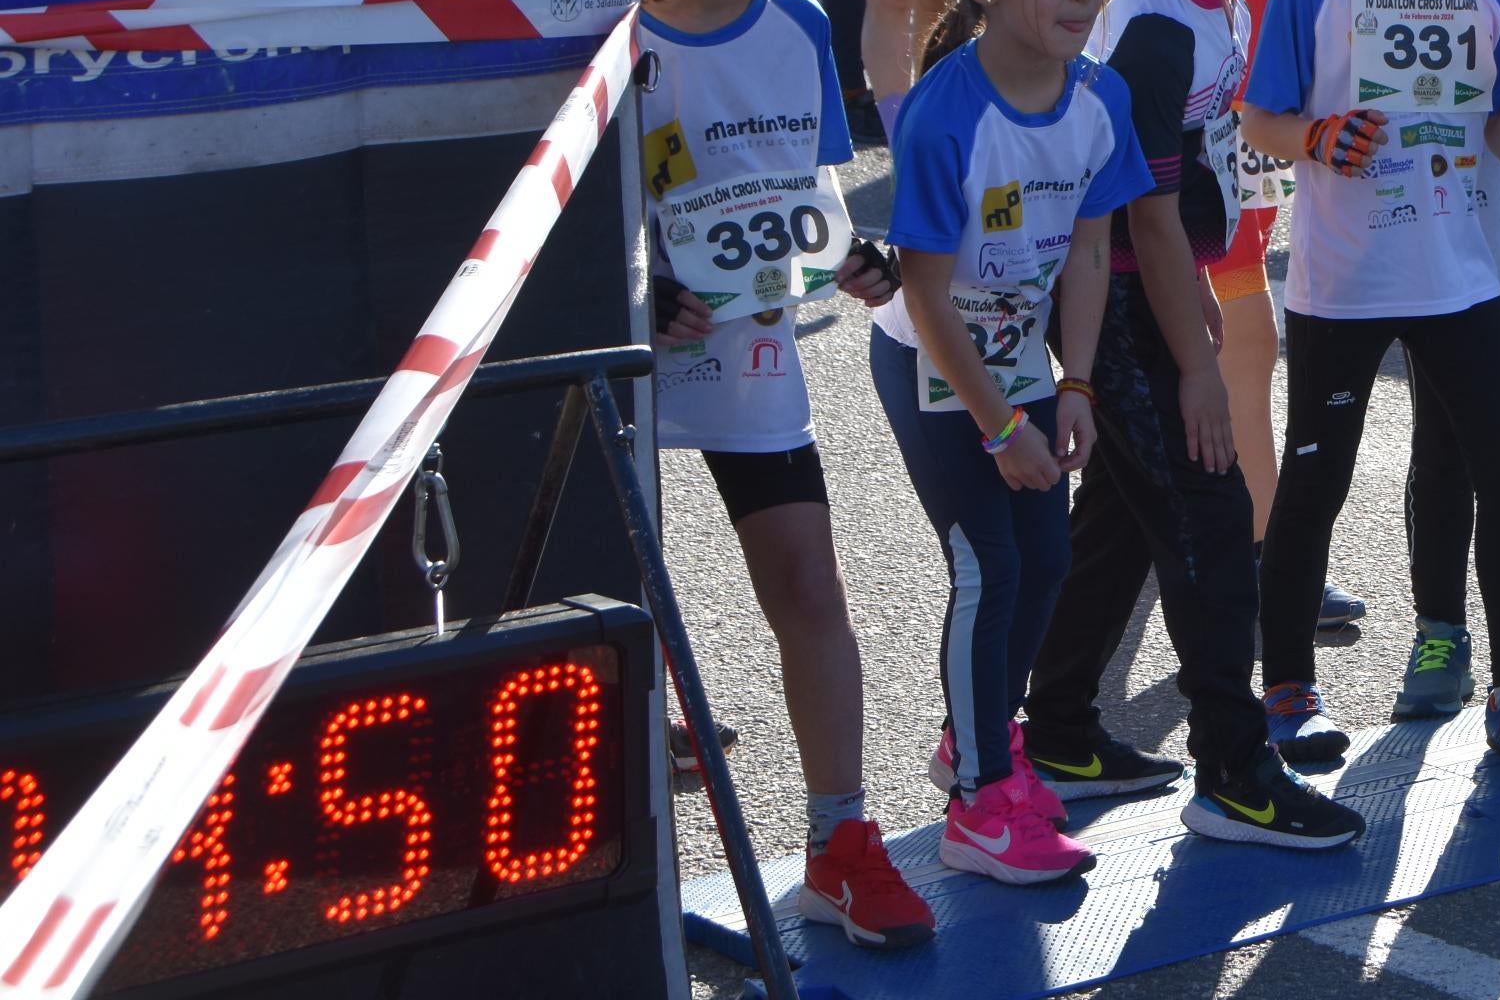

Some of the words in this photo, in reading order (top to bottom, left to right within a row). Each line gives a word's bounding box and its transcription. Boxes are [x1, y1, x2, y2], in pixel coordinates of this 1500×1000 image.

[584, 0, 593, 9] de
[1383, 24, 1477, 71] 331
[672, 203, 682, 216] IV
[685, 186, 731, 214] DUATLÓN
[732, 176, 762, 200] CROSS
[763, 175, 818, 192] VILLAMAYOR
[734, 201, 758, 213] Febrero
[767, 195, 783, 206] 2024
[706, 205, 830, 271] 330
[755, 284, 787, 296] DUATLÓN
[951, 295, 993, 313] DUATLÓN
